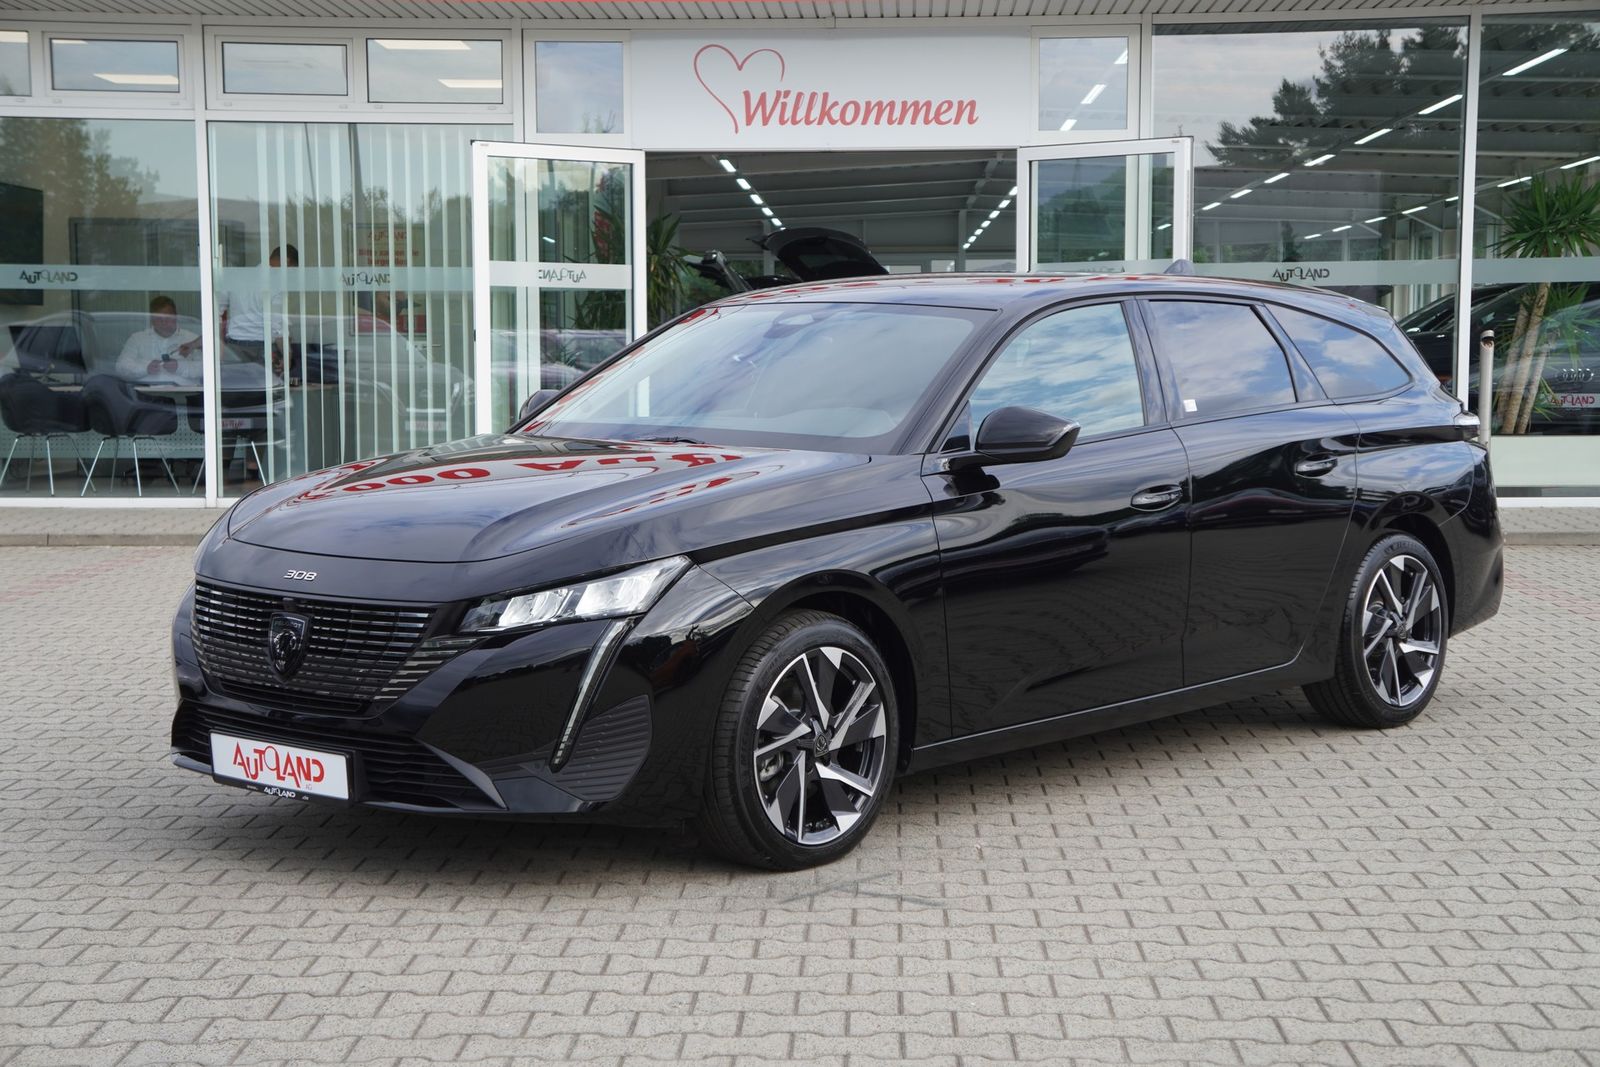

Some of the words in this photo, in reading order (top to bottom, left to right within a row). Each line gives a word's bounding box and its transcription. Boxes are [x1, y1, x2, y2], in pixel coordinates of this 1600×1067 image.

[742, 89, 979, 127] Willkommen
[19, 269, 79, 284] AUTOLAND
[1272, 266, 1330, 282] AUTOLAND
[283, 569, 318, 581] 308
[232, 741, 325, 788] AUTOLAND
[263, 786, 297, 799] AUTOLAND
